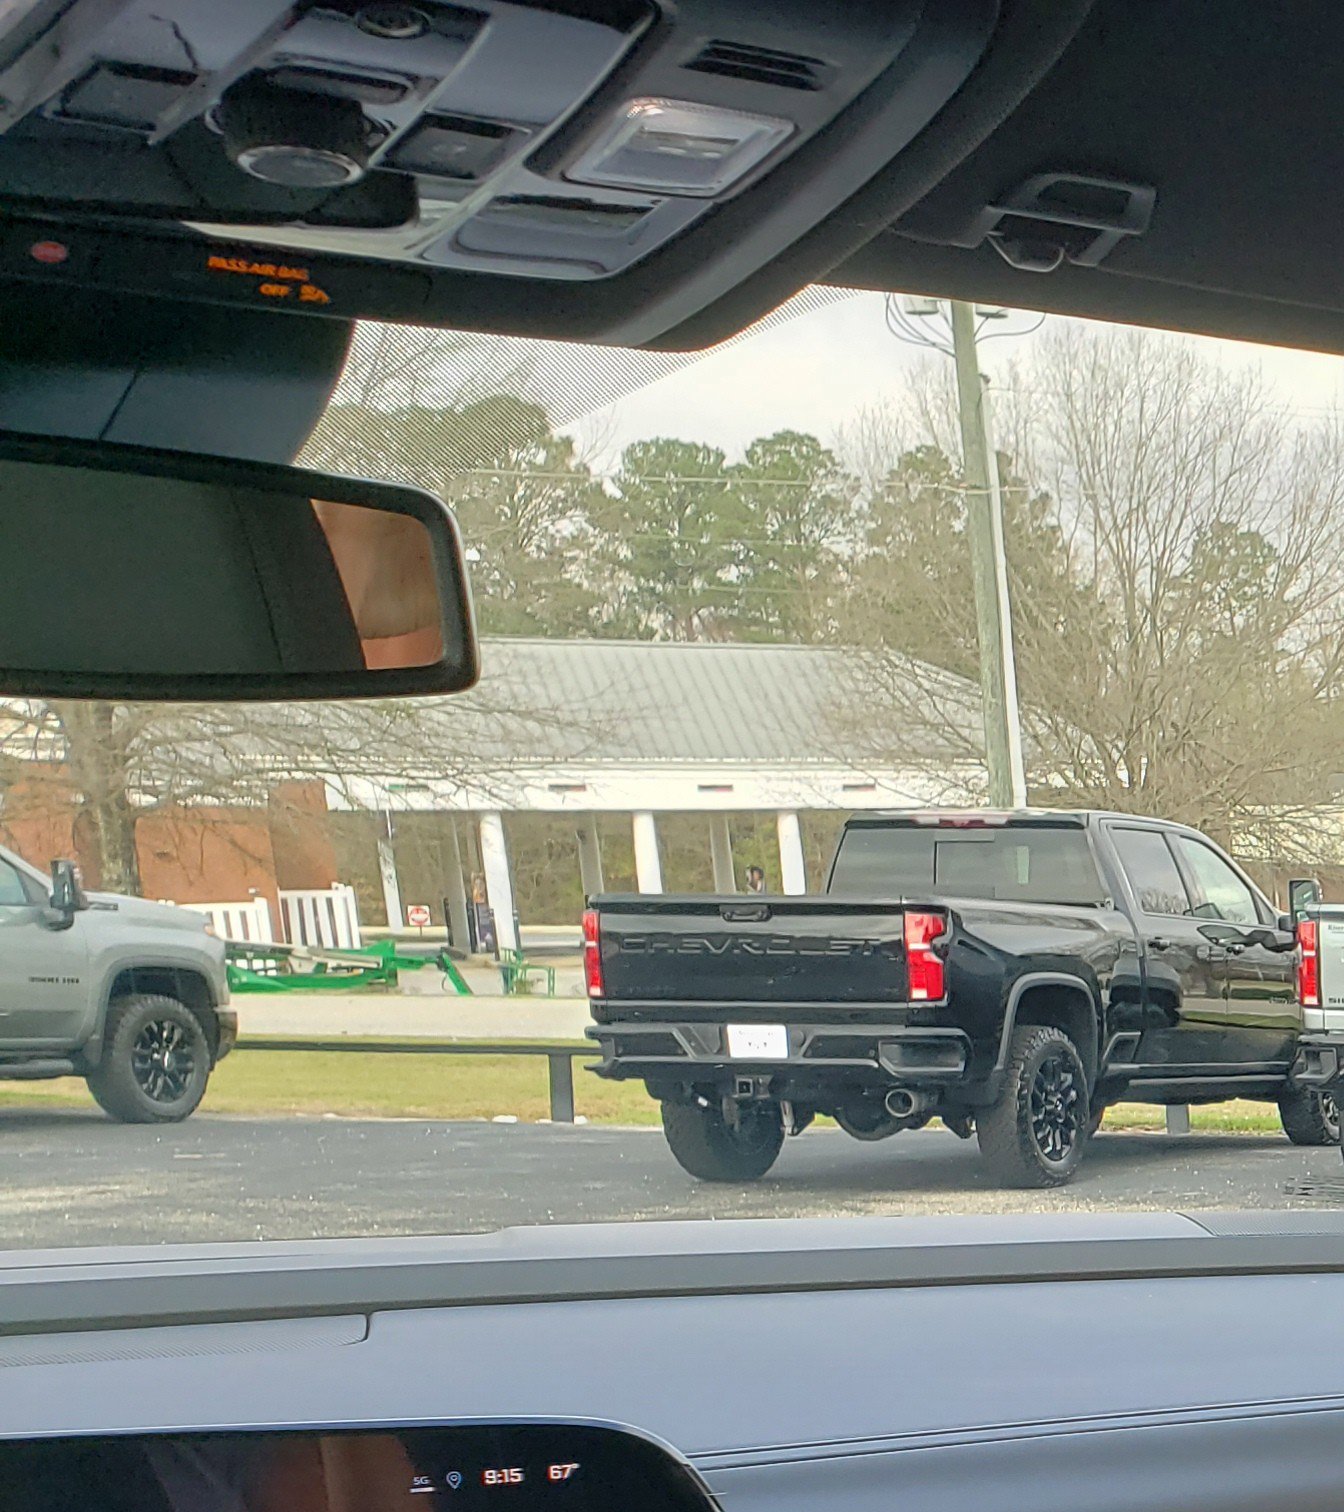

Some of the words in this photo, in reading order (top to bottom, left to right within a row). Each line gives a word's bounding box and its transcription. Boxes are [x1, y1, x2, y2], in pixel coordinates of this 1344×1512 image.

[259, 283, 291, 298] OFF
[483, 1467, 523, 1486] 9:15
[548, 1462, 580, 1480] 67°
